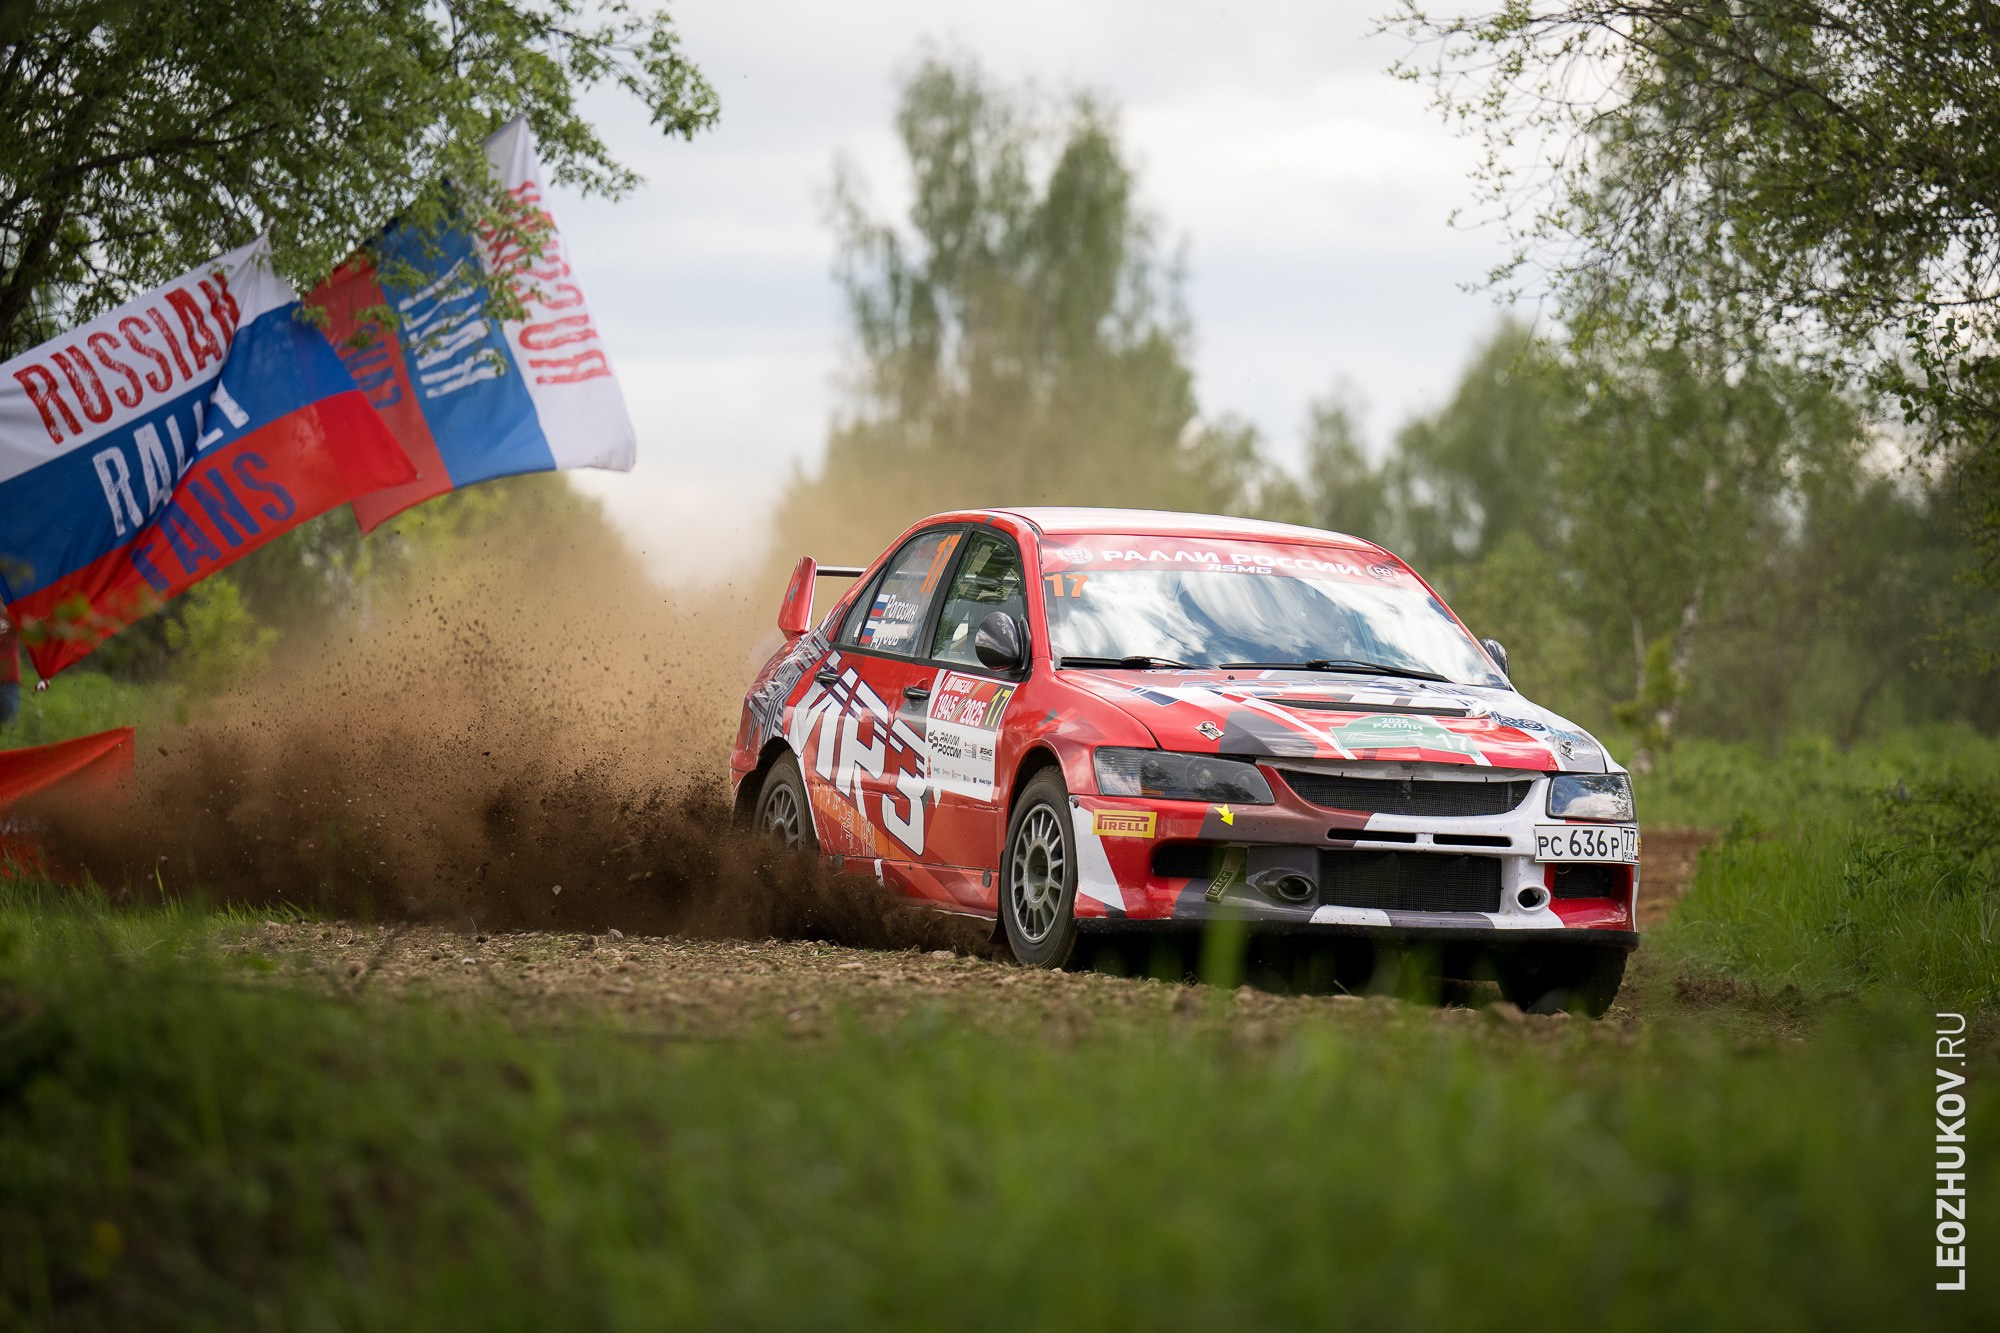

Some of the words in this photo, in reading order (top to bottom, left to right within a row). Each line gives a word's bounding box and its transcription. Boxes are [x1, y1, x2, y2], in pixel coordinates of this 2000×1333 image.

[13, 272, 240, 444] RUSSIAN
[131, 452, 297, 592] FANS
[1101, 549, 1221, 563] РАЛЛИ
[1230, 553, 1362, 577] РОССИИ
[1045, 574, 1089, 598] 17
[934, 693, 960, 720] 1945
[960, 698, 988, 727] 2025
[985, 688, 1013, 727] 17
[1381, 717, 1409, 725] 2025
[1373, 722, 1424, 731] РАЛЛИ
[1436, 733, 1468, 751] 17
[1097, 814, 1149, 832] PIRELLI
[1569, 829, 1608, 857] 636
